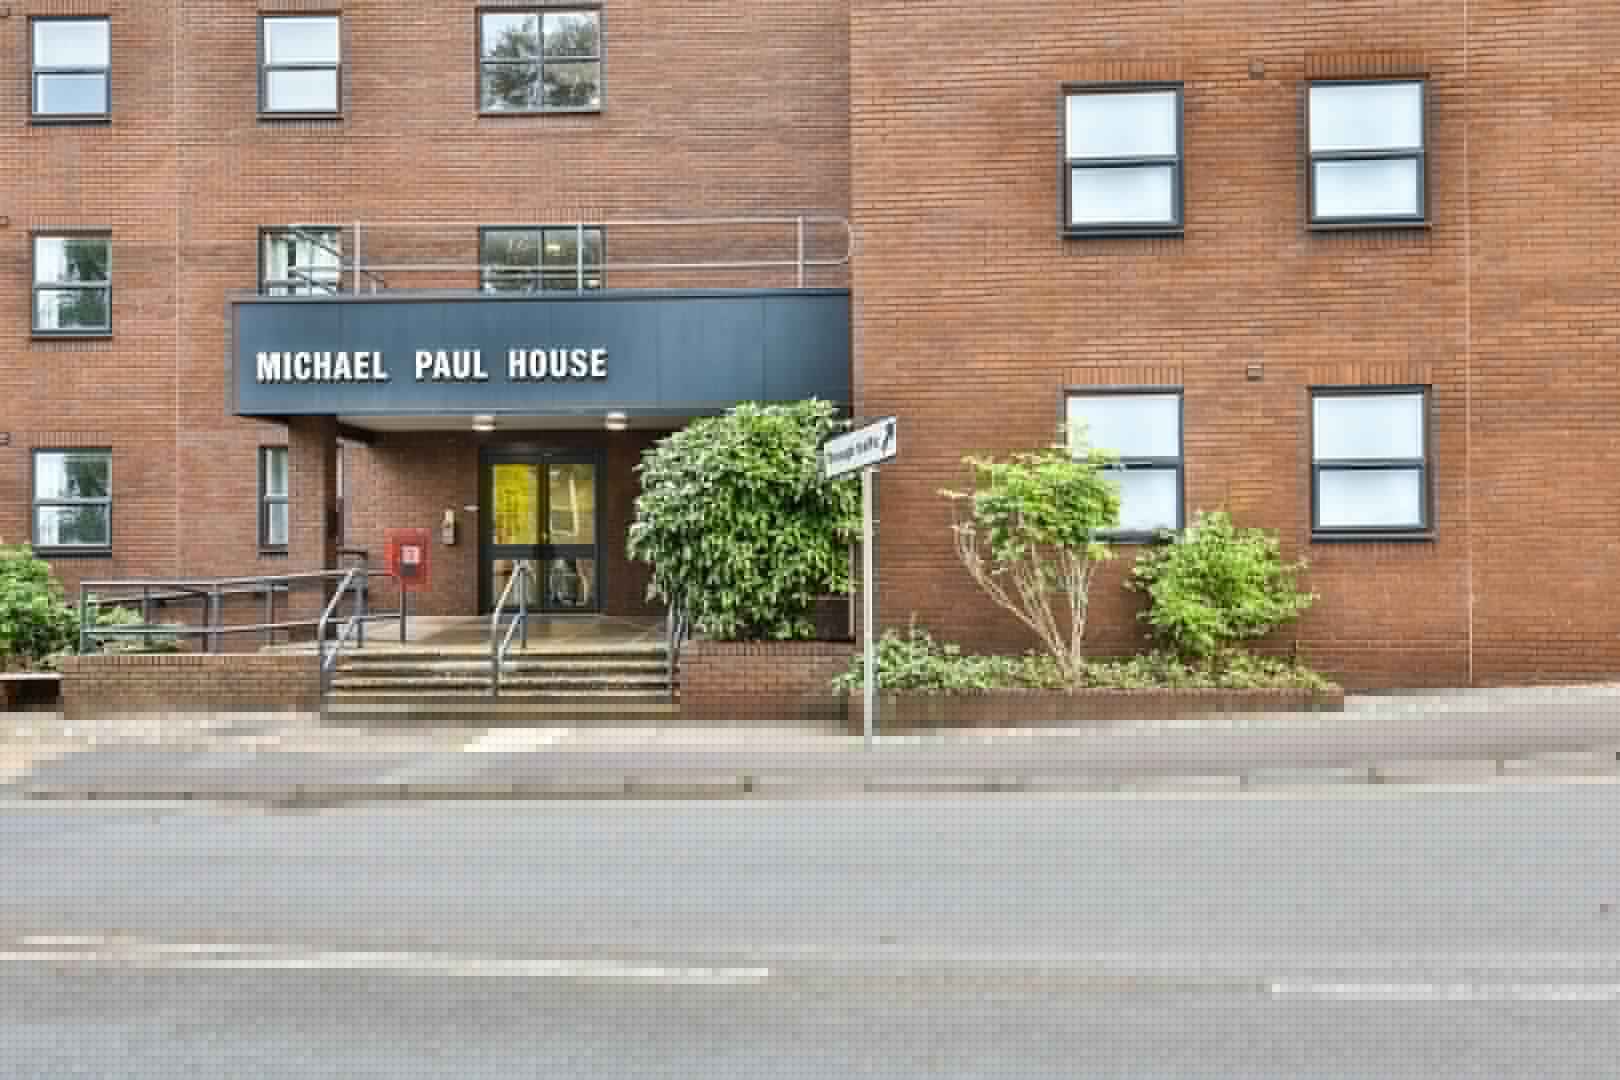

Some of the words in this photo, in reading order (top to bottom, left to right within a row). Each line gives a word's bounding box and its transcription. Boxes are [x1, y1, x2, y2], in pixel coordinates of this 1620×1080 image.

[256, 351, 389, 381] MICHAEL
[415, 350, 488, 380] PAUL
[508, 348, 607, 379] HOUSE
